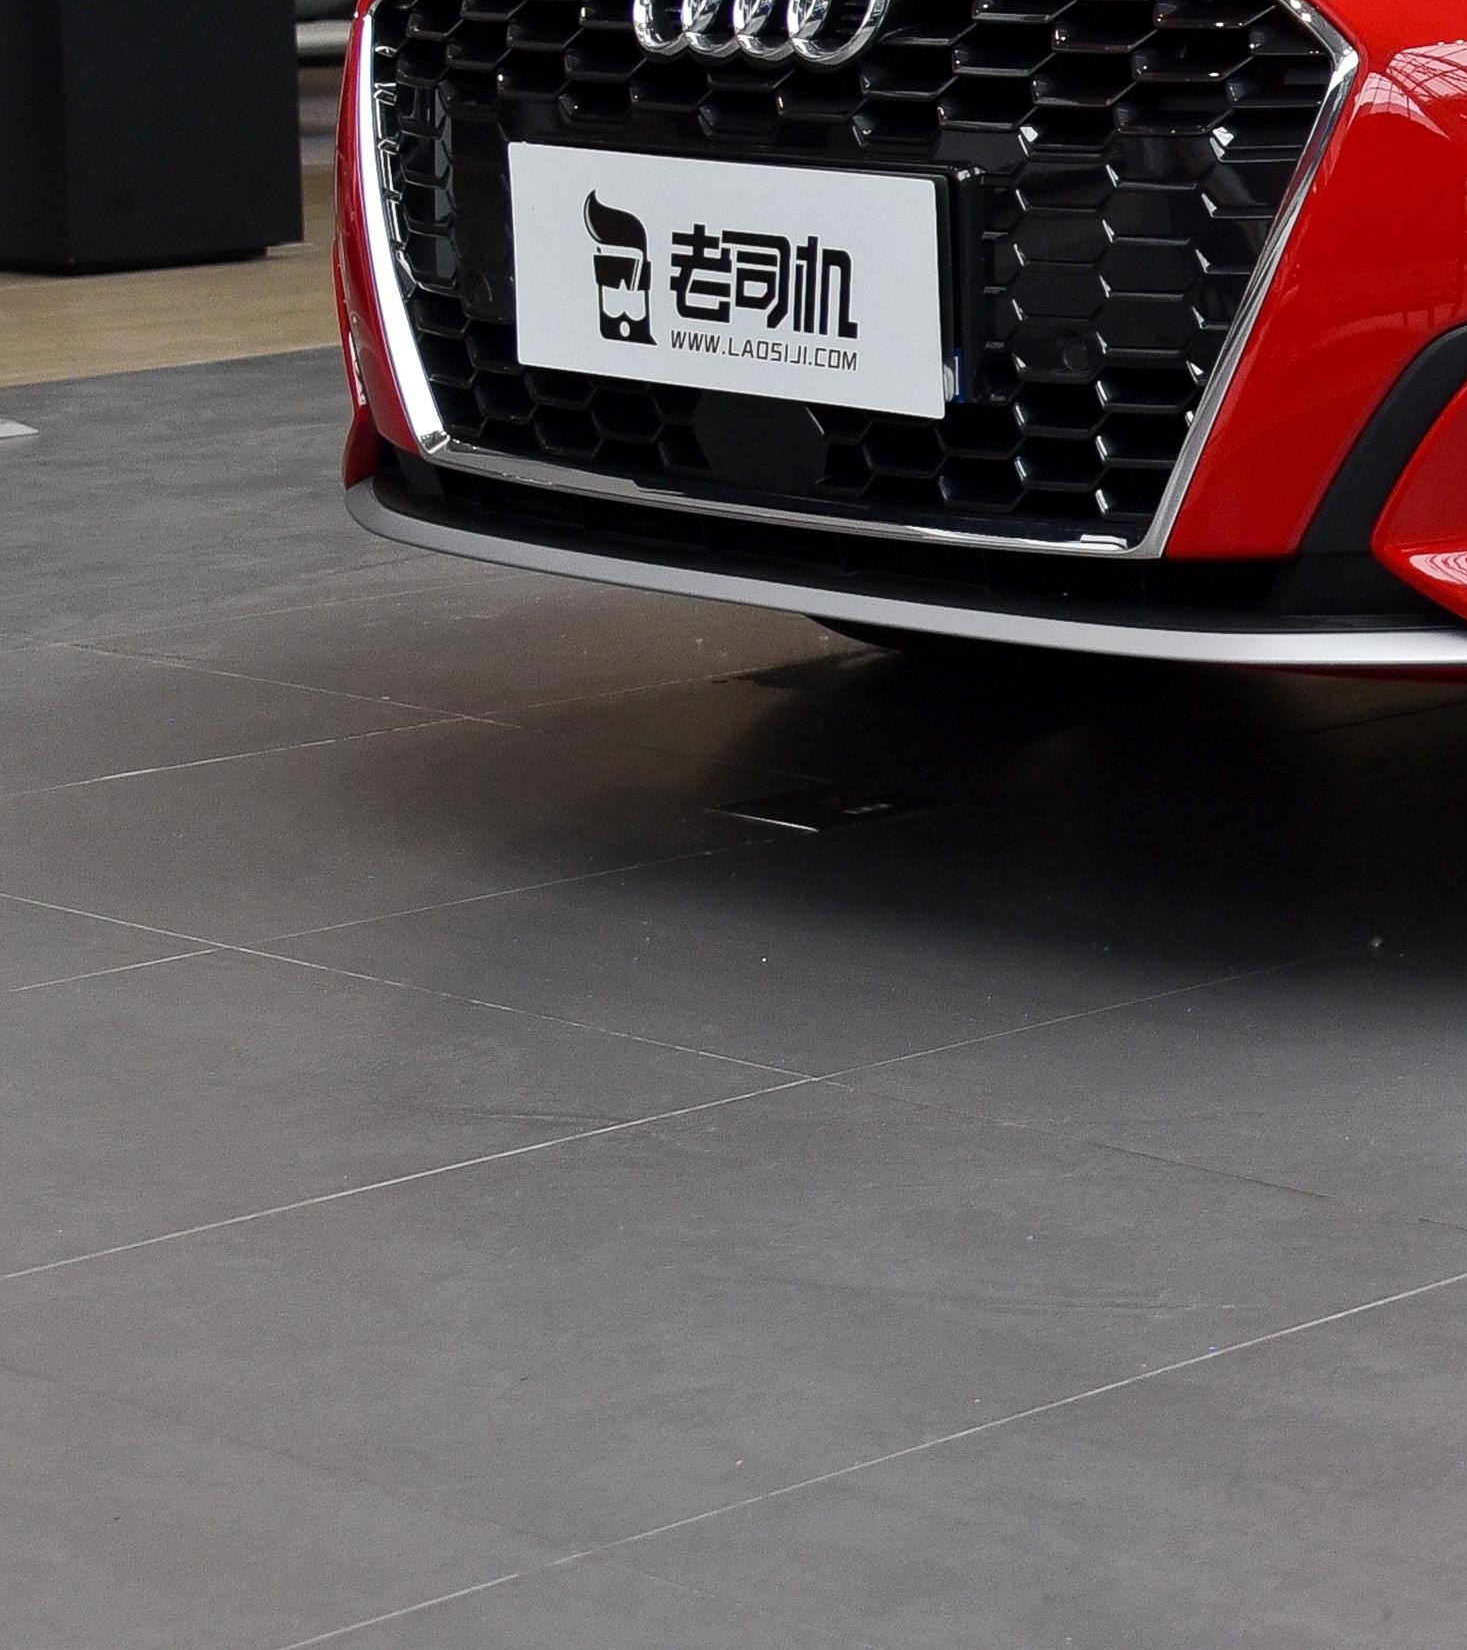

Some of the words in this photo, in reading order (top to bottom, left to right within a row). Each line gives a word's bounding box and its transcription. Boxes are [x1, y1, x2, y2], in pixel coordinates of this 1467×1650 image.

[670, 223, 858, 339] 老司机
[671, 330, 857, 371] WWW.LAOSIJI.COM
